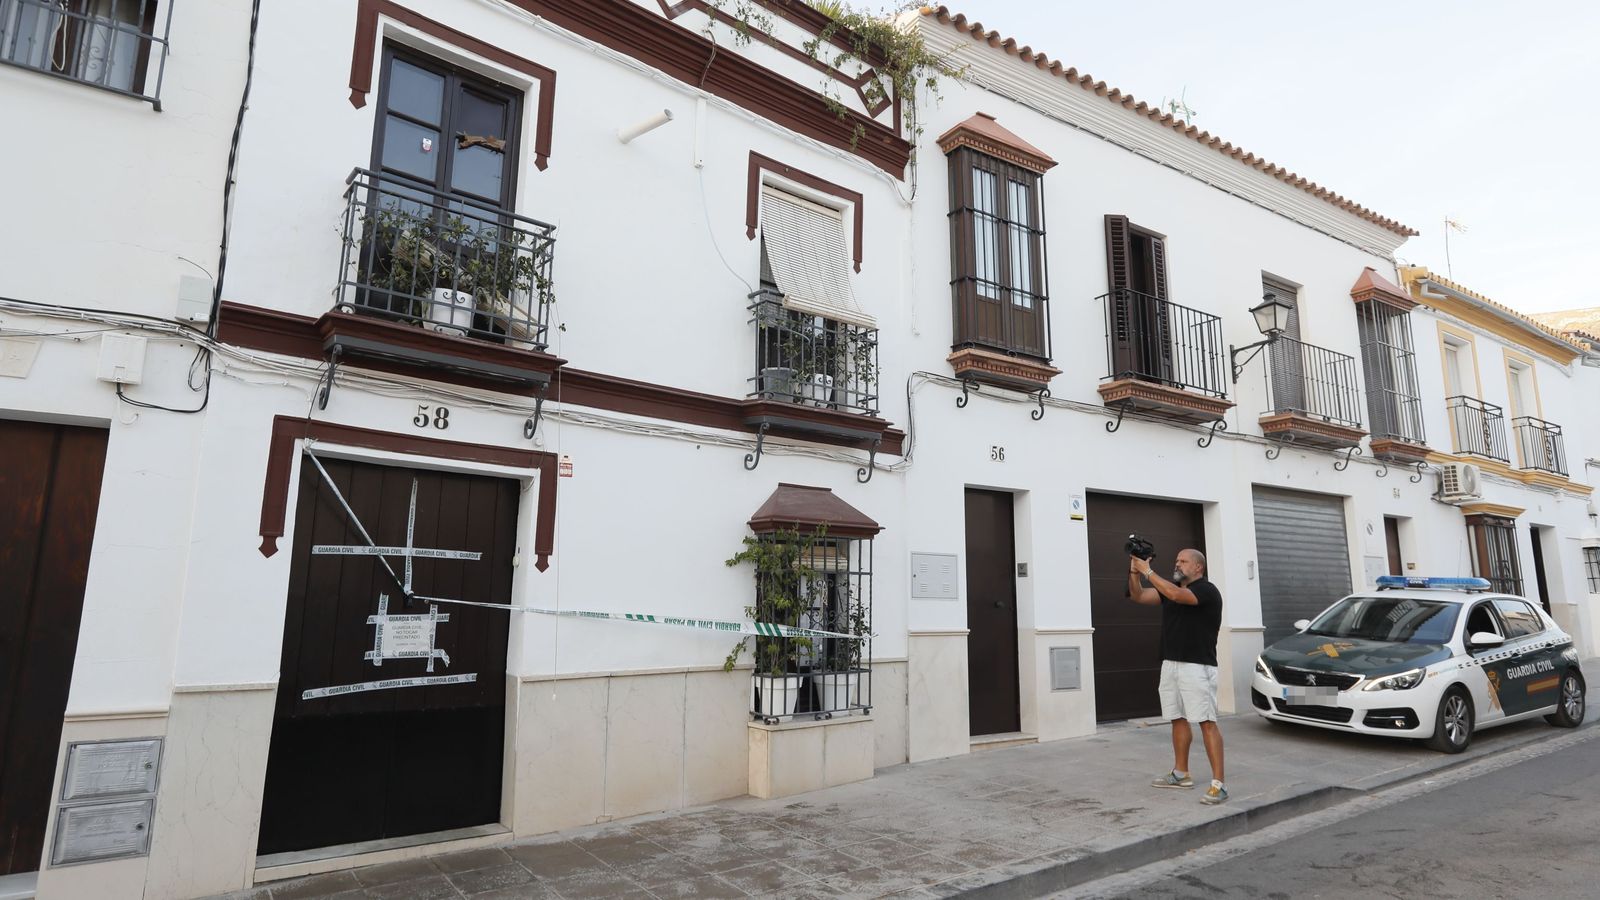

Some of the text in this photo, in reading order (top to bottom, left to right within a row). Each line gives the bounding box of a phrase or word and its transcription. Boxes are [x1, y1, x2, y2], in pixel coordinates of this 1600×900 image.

[413, 404, 450, 430] 58
[991, 445, 1005, 461] 56
[698, 620, 713, 630] CIVIL
[715, 622, 742, 632] GUARDIA
[1506, 660, 1555, 680] GUARDIA CIVIL
[328, 686, 351, 695] GUARDIA
